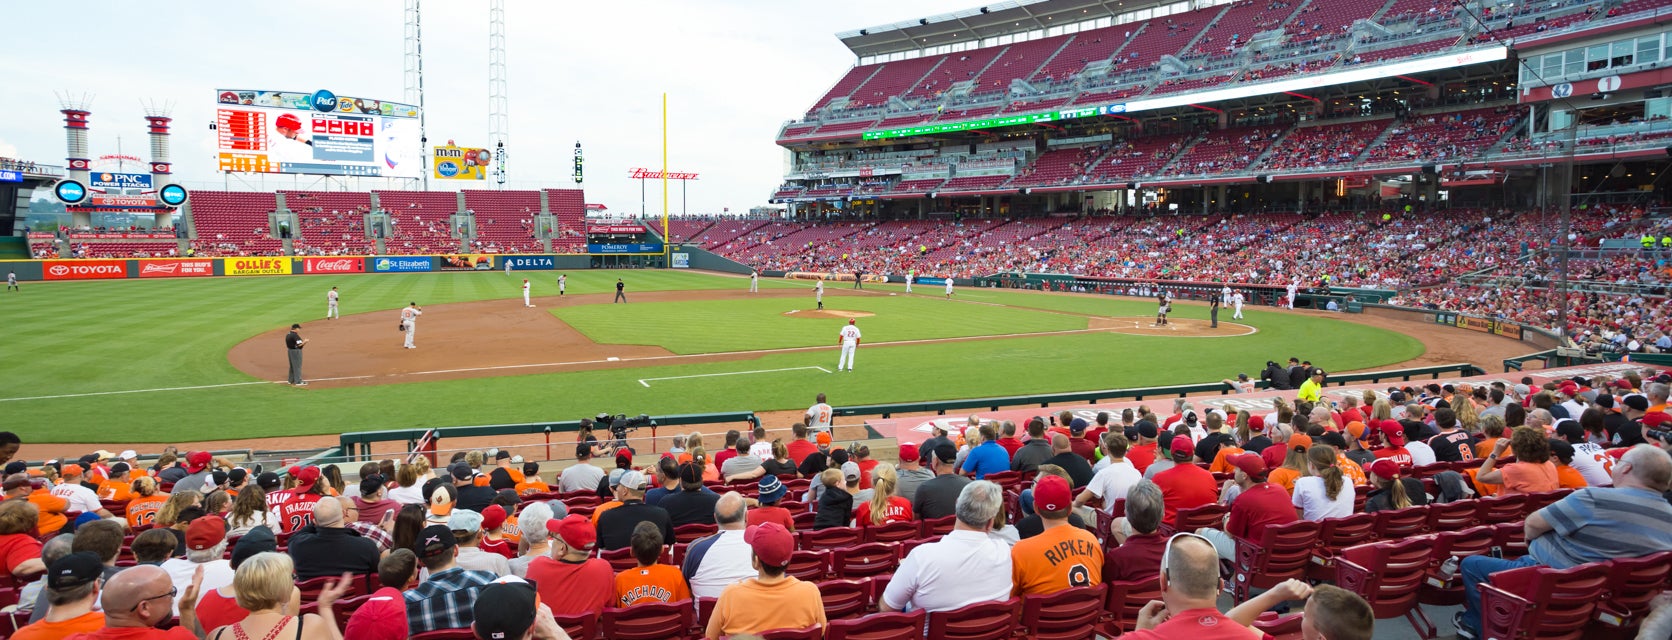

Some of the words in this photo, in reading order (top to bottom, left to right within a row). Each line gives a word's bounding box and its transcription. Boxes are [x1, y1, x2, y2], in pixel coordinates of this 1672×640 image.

[1605, 79, 1612, 90] 1
[316, 97, 335, 106] P&G
[115, 175, 142, 183] PNC
[71, 265, 122, 274] TOYOTA
[847, 330, 855, 338] 22
[819, 411, 829, 423] 21
[1459, 443, 1473, 462] 8
[1044, 540, 1094, 566] RIPKEN
[621, 584, 672, 607] MACHADO
